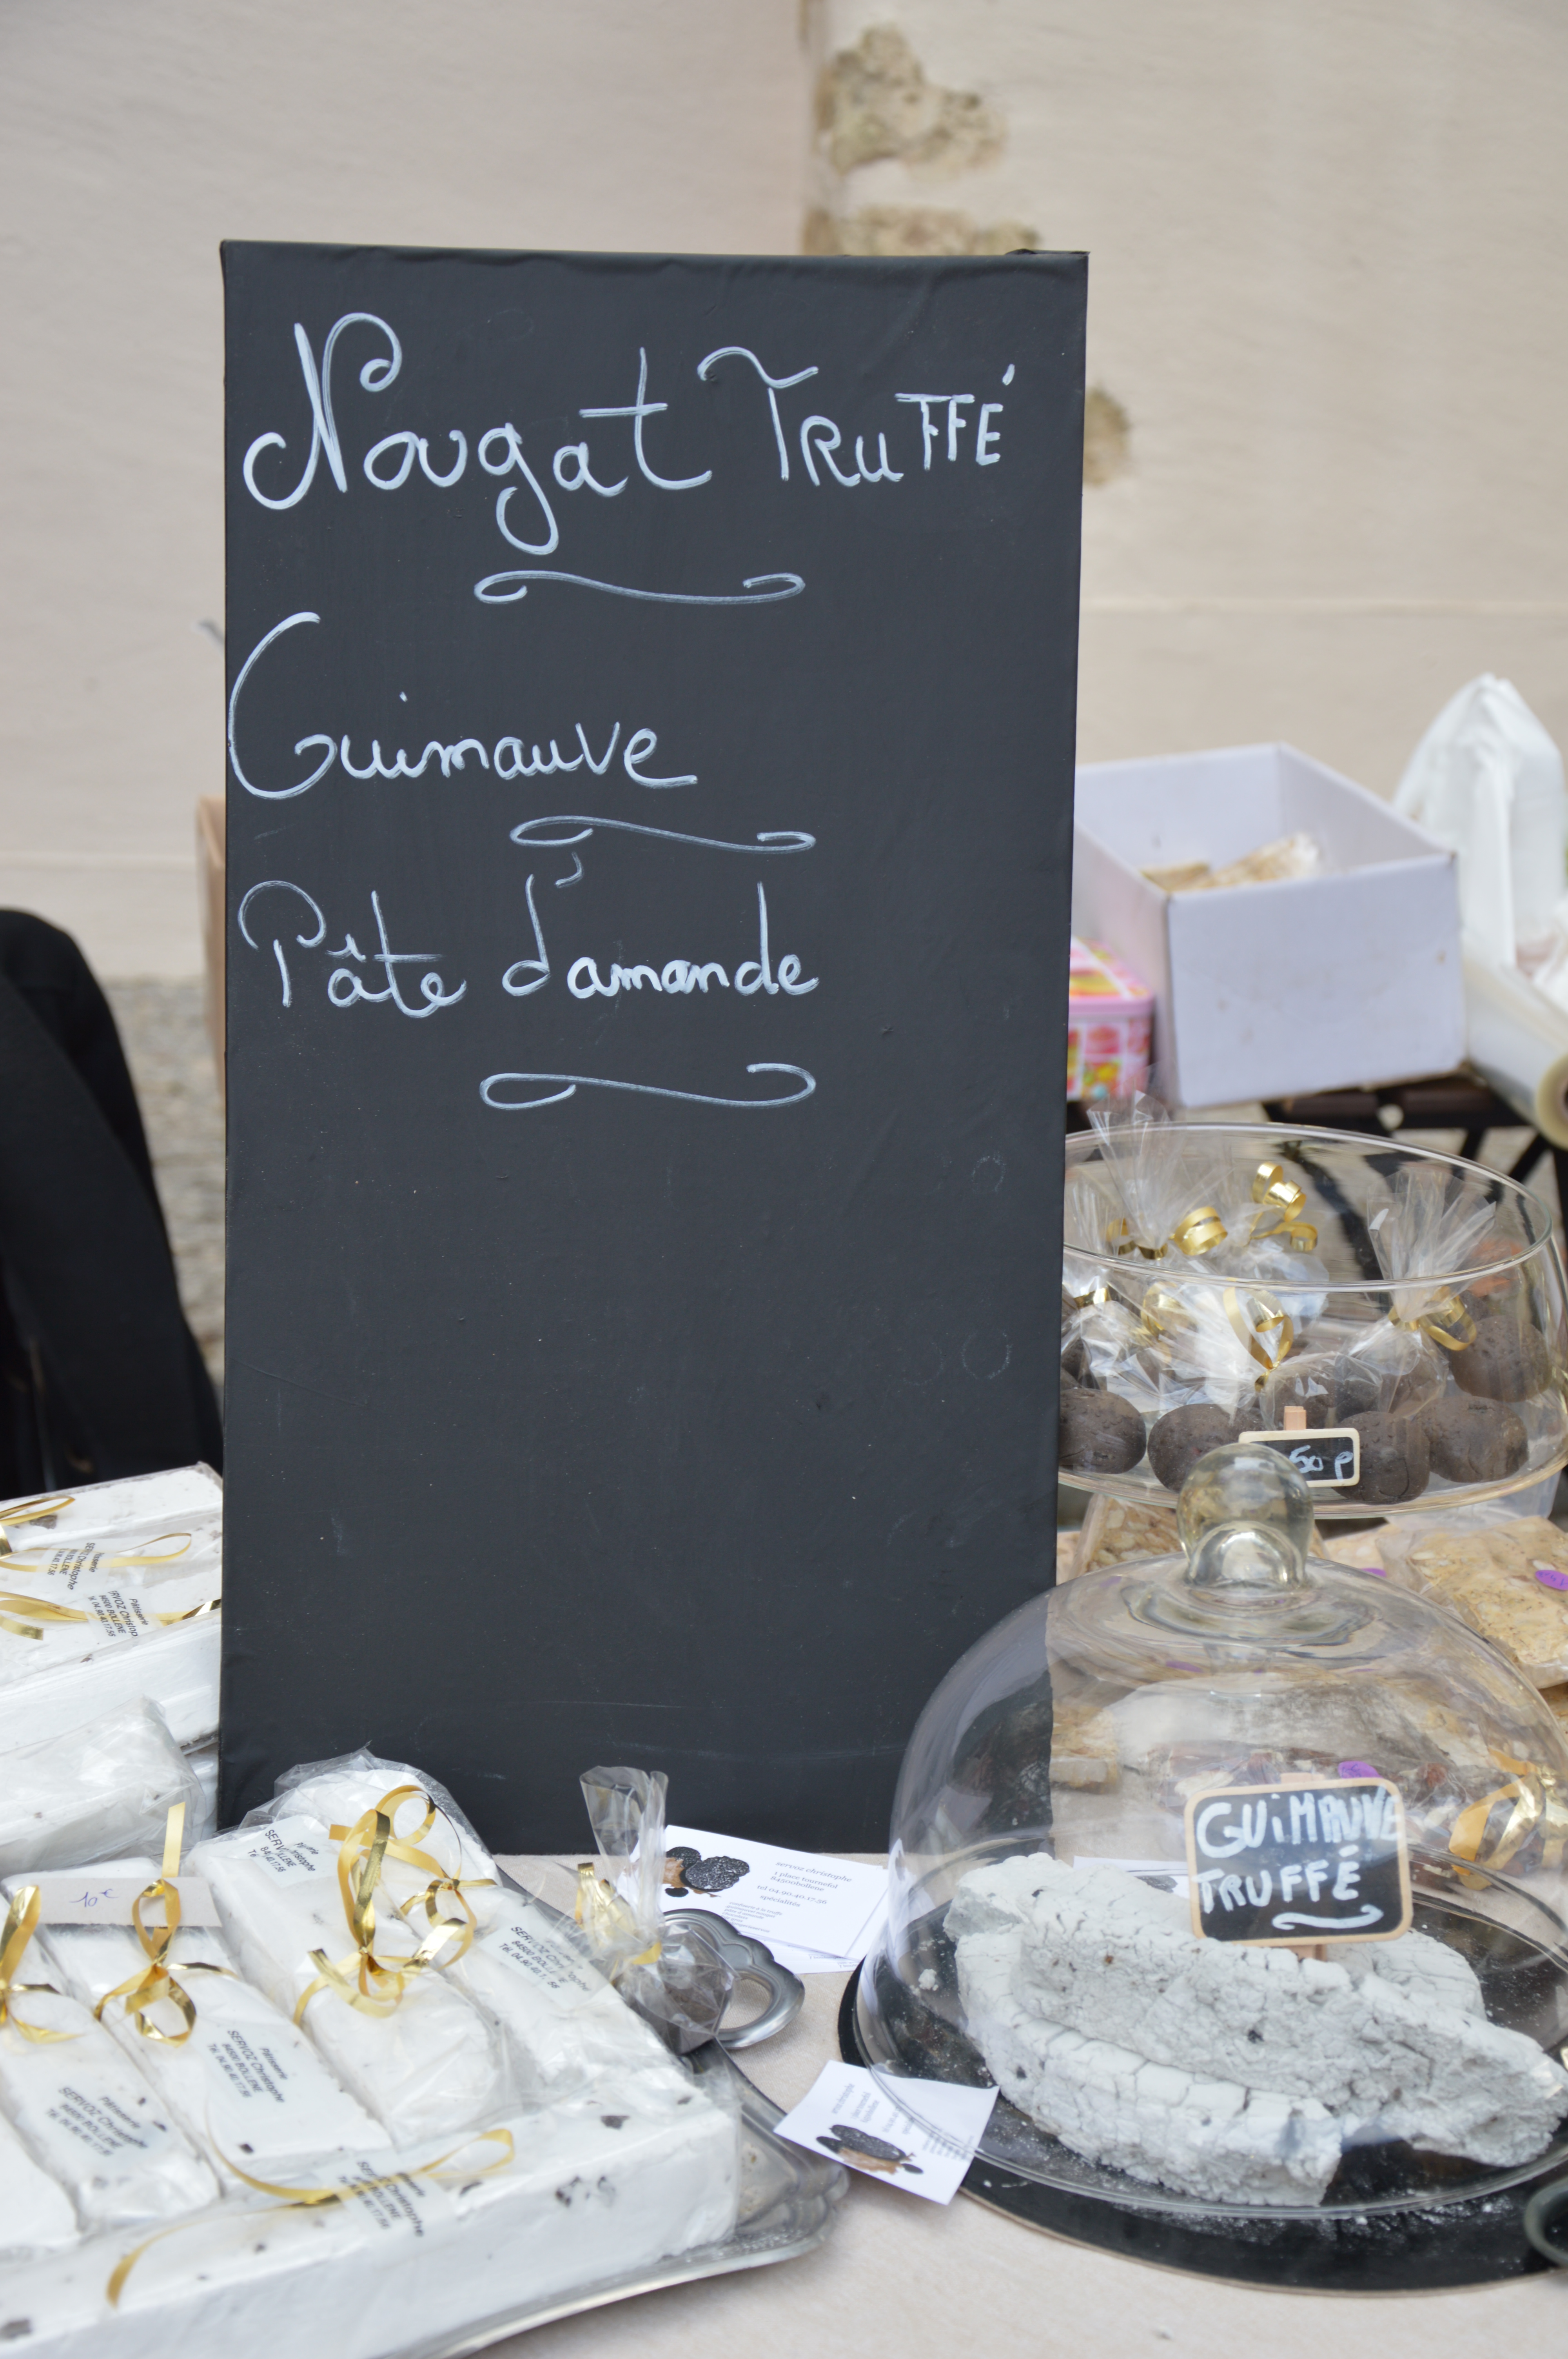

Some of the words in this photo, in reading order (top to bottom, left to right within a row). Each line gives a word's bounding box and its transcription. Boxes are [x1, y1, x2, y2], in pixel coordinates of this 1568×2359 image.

[243, 313, 713, 555] Nougat
[227, 612, 698, 800] Guimauve
[238, 880, 467, 1018] Pâte
[502, 852, 819, 998] d'amande
[59, 1554, 74, 1576] BOLLENE
[67, 1555, 87, 1590] Christophe
[91, 1602, 116, 1637] 04.90.40.17.56
[106, 1609, 127, 1634] BOLLENE
[129, 1598, 149, 1625] Pâtisserie
[770, 1876, 824, 1892] 84500bollene
[775, 1862, 805, 1871] servoz
[806, 1868, 852, 1883] christophe
[801, 1877, 838, 1889] tournefol
[1191, 1845, 1361, 1914] TRUFFÉ
[69, 1888, 119, 1907] 10€
[759, 1895, 801, 1908] spécialités
[769, 1888, 827, 1905] 04.90.40.17.56
[512, 1941, 535, 1956] 84500
[227, 2030, 258, 2061] SERVOZ
[250, 2063, 285, 2103] Christophe
[235, 2063, 263, 2093] BOLLENE
[59, 2087, 102, 2117] SERVOZ
[82, 2121, 124, 2150] BOLLENE
